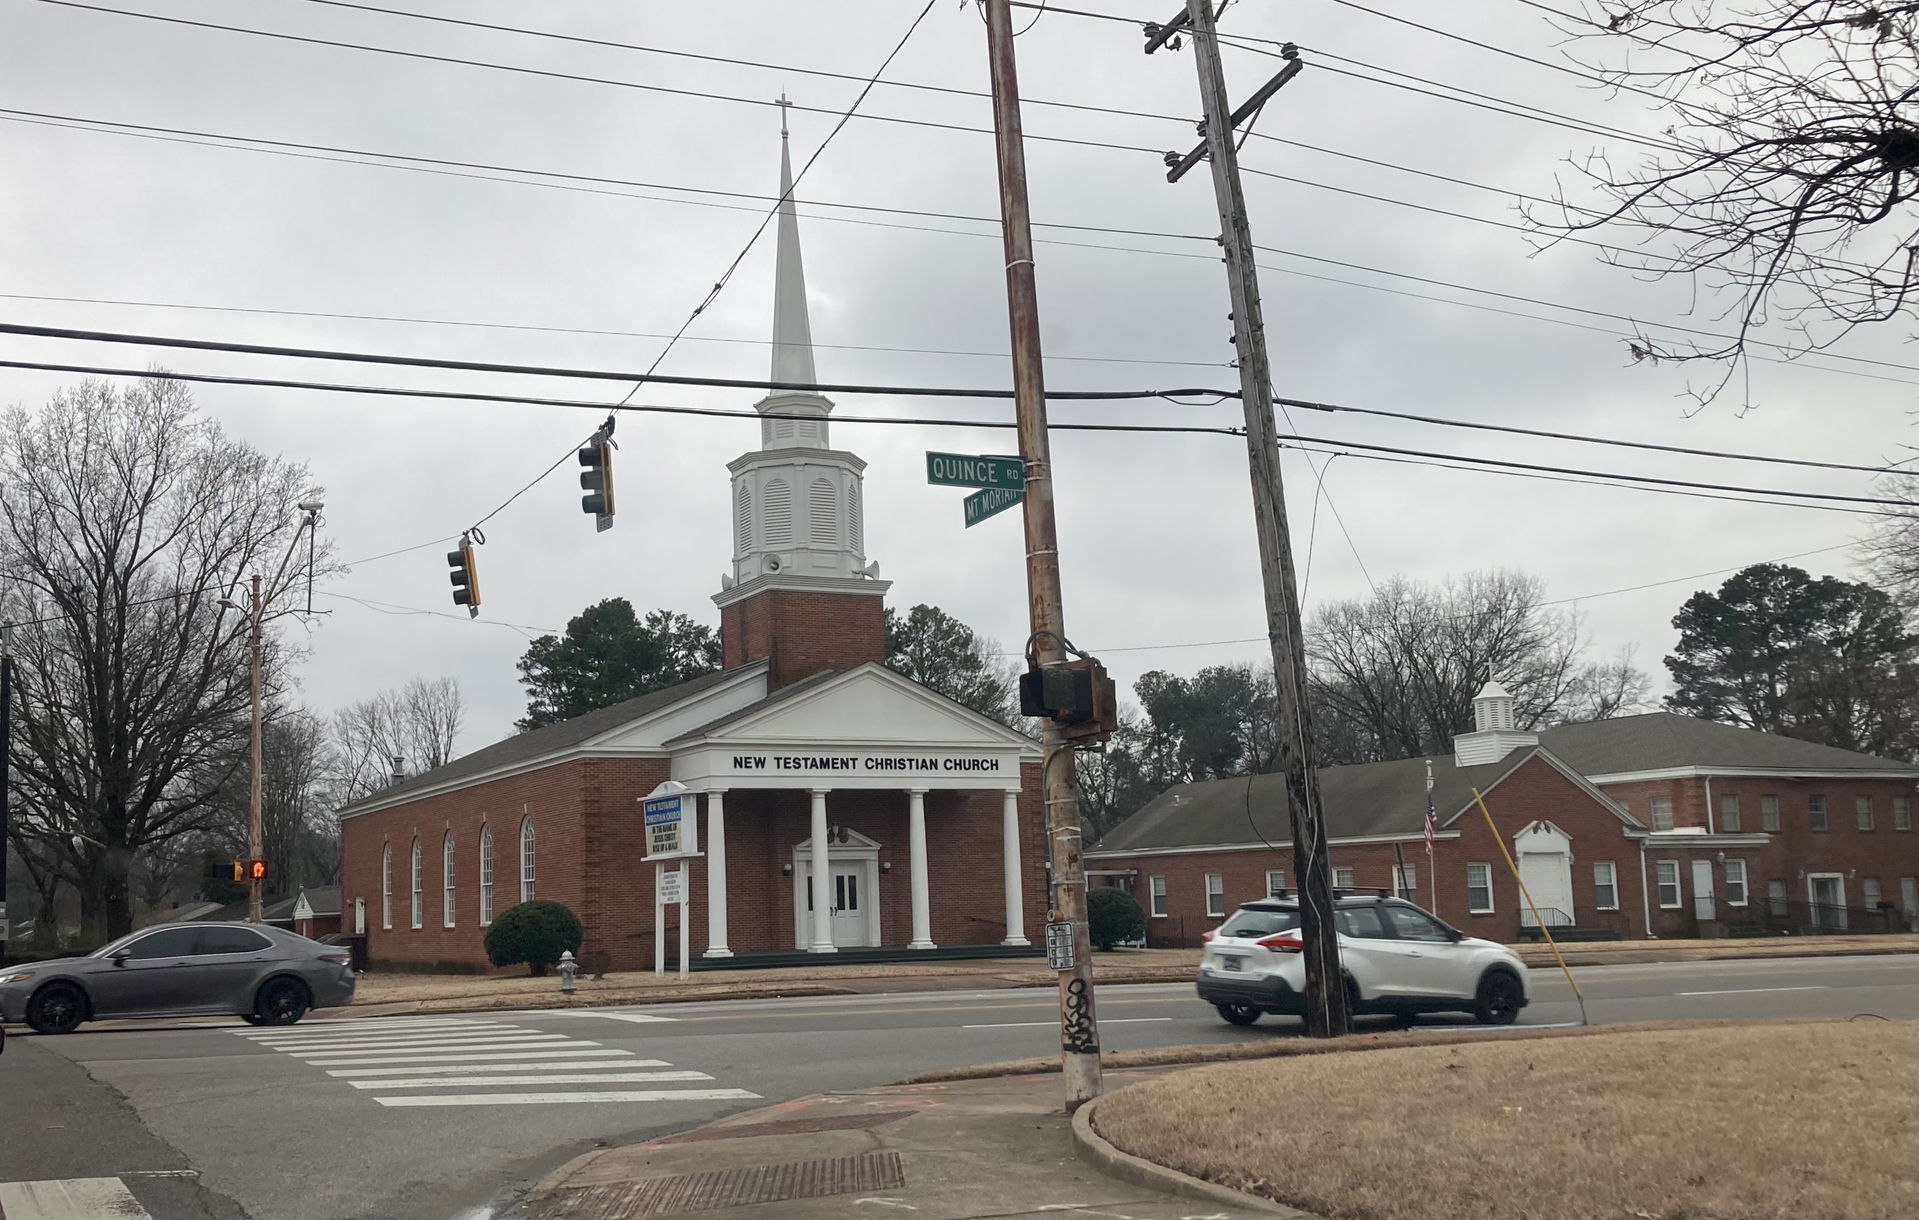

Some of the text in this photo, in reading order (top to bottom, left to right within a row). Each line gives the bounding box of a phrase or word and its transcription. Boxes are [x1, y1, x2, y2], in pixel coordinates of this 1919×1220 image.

[933, 458, 1019, 483] QUINCE RD
[967, 498, 979, 521] MT
[733, 756, 999, 771] NEW TESTAMENT CHRISTIAN CHURCH
